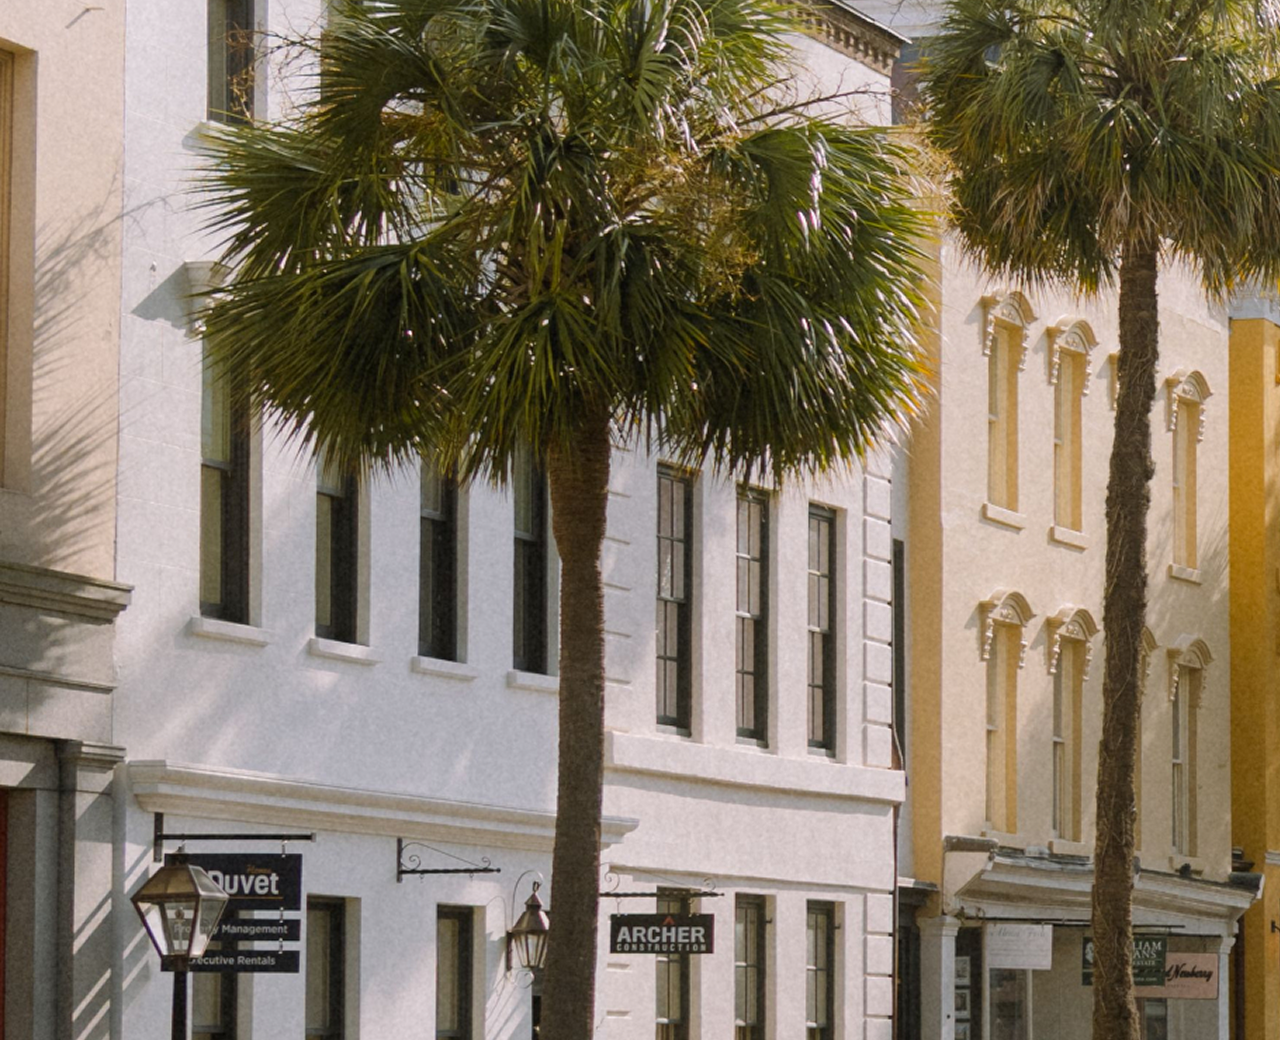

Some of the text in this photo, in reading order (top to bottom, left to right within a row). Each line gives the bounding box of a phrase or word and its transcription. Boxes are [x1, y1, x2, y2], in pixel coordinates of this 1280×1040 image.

[207, 870, 279, 895] Duvet
[222, 925, 288, 935] Management
[617, 926, 706, 943] ARCHER
[237, 955, 276, 965] Rentals
